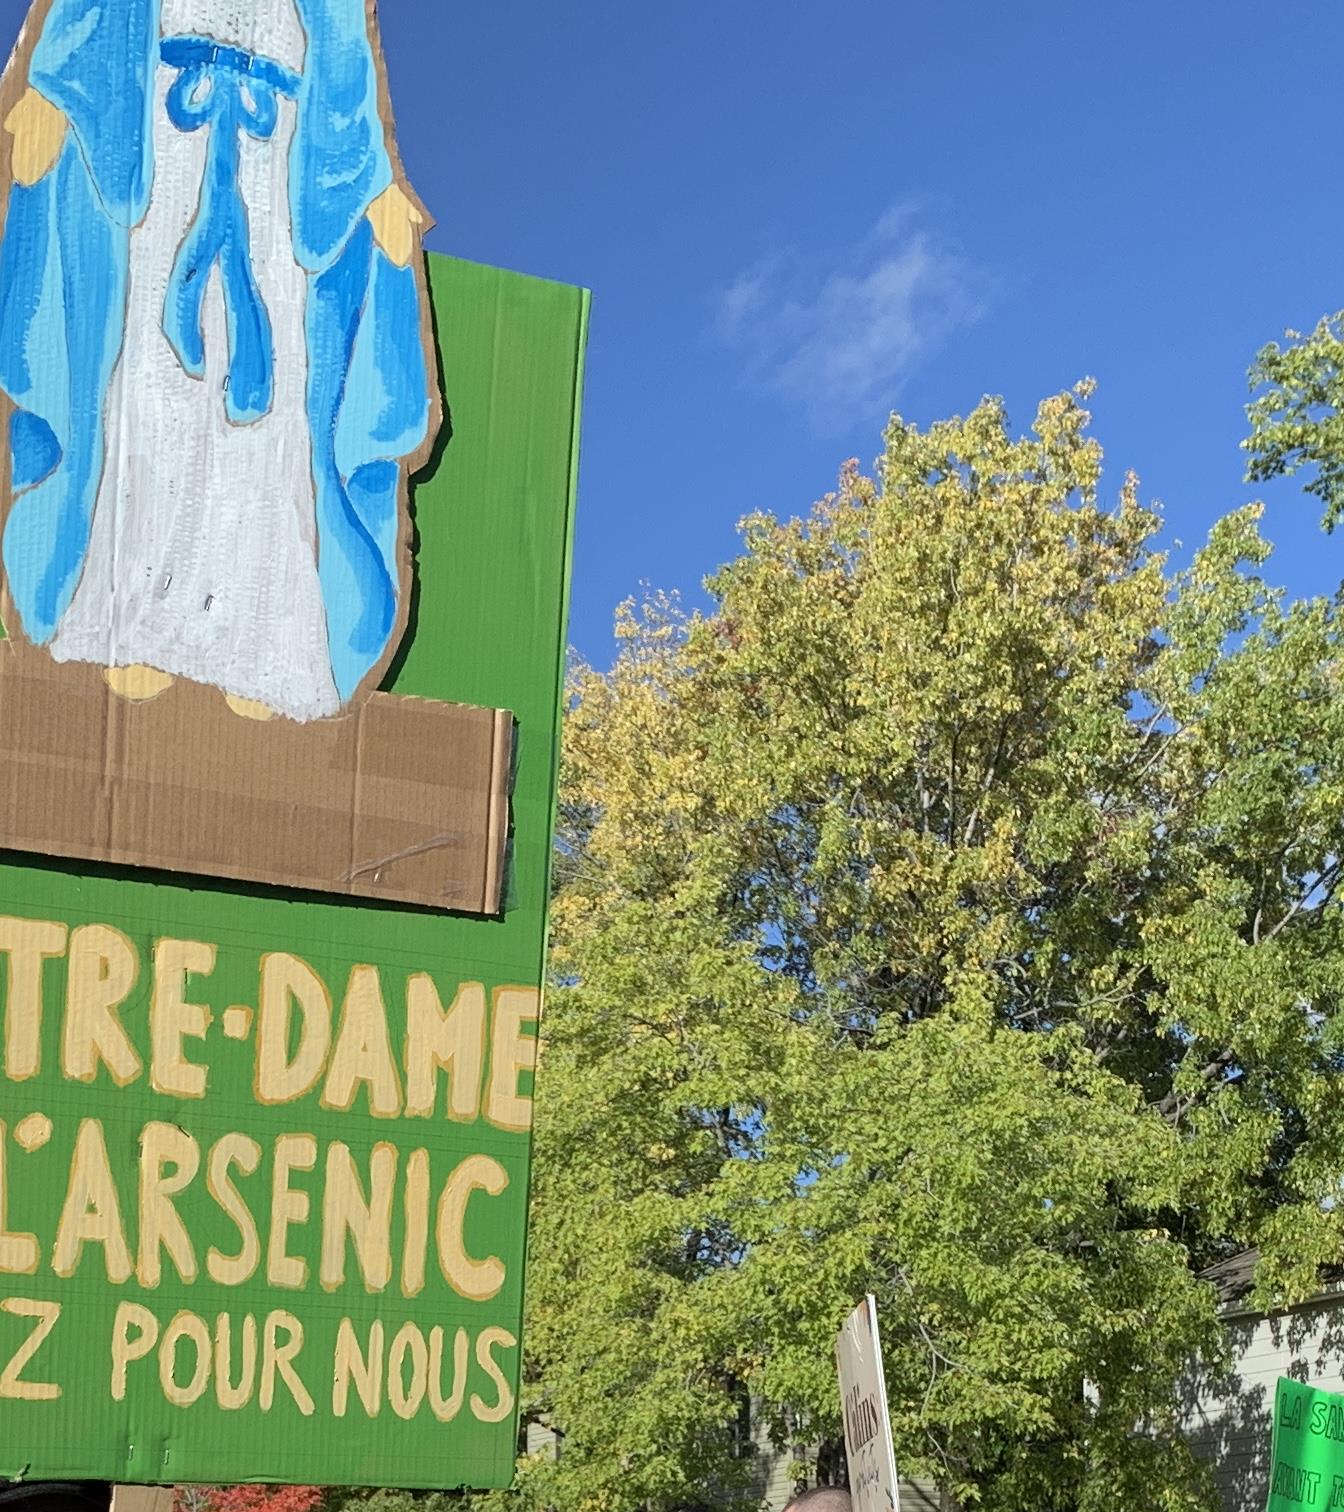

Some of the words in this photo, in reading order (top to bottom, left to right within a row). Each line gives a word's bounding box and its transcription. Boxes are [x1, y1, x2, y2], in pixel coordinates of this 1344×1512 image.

[111, 1300, 316, 1417] POUR
[332, 1317, 518, 1423] NOUS
[1280, 1392, 1302, 1430] LA
[1272, 1462, 1322, 1505] AVANT
